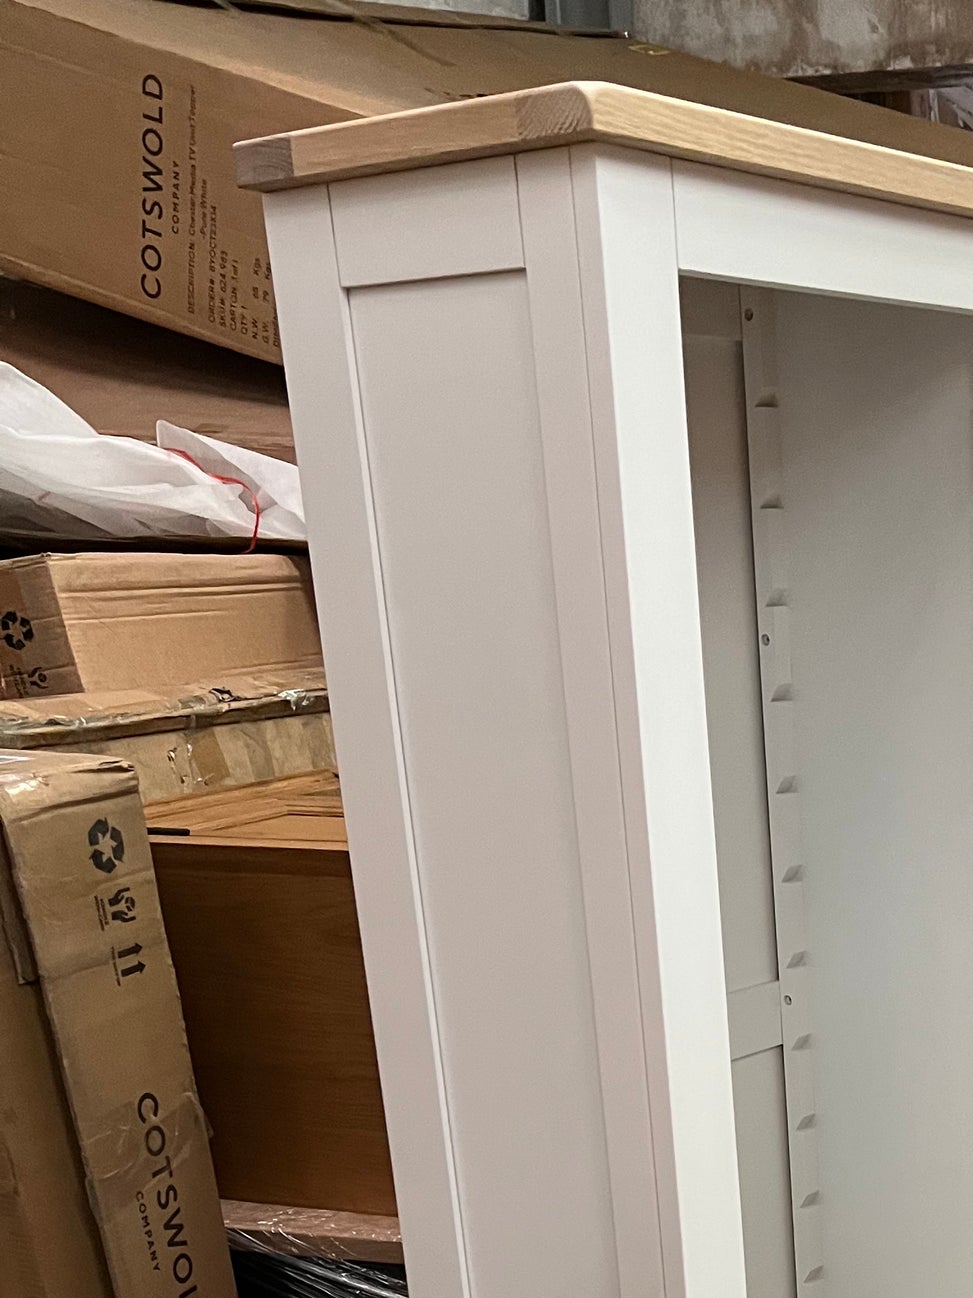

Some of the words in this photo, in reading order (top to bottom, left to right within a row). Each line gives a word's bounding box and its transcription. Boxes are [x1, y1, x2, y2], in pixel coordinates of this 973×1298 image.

[141, 74, 164, 299] COTSWOLD
[172, 160, 180, 234] COMPANY
[136, 1190, 161, 1272] COMPANY
